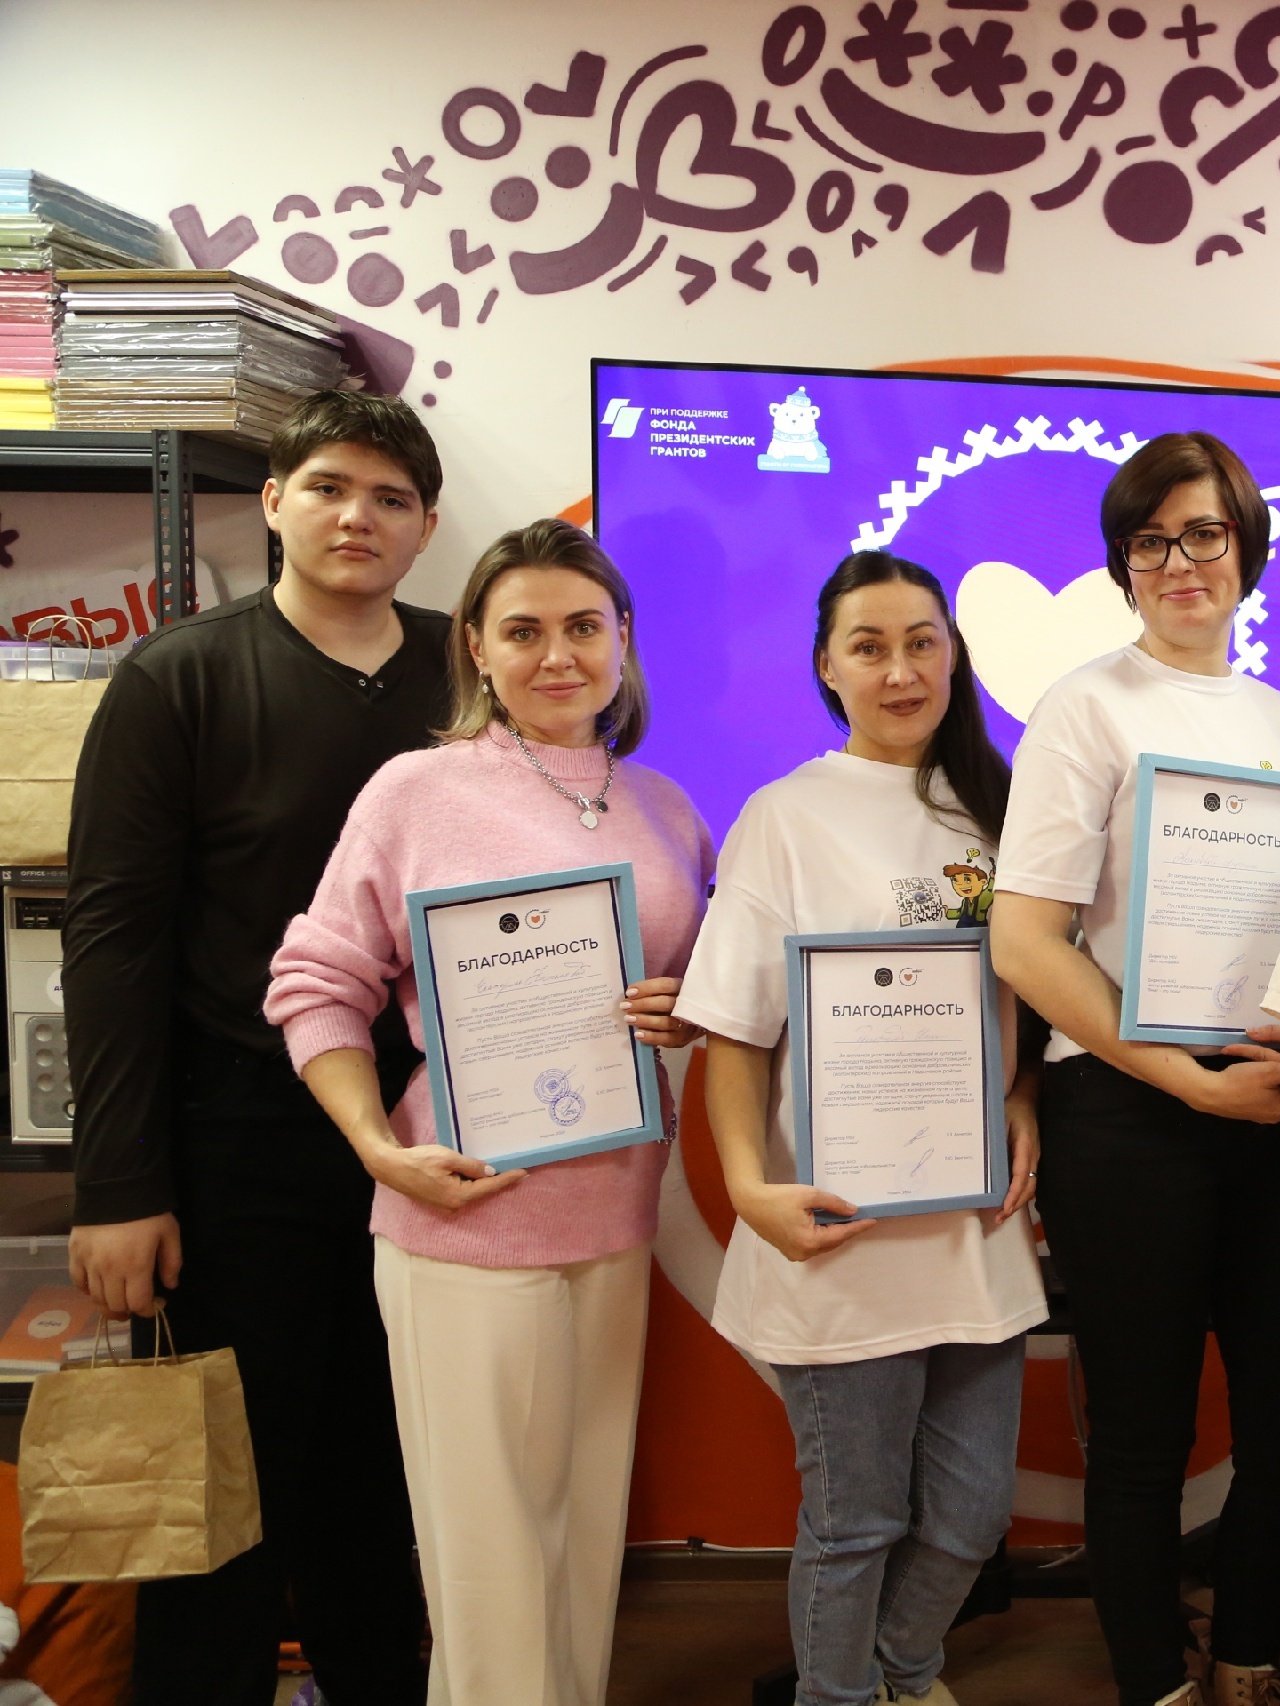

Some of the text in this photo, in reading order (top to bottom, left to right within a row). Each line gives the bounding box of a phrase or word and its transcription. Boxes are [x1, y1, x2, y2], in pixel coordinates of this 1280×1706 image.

[650, 408, 729, 419] ПРИ ПОДДЕРЖКЕ
[650, 419, 696, 431] ФОНДА
[650, 432, 755, 446] ПРЕЗИДЕНТСКИХ
[650, 446, 706, 458] ГРАНТОВ
[457, 937, 599, 973] БЛАГОДАРНОСТЬ
[832, 1003, 964, 1018] БЛАГОДАРНОСТЬ
